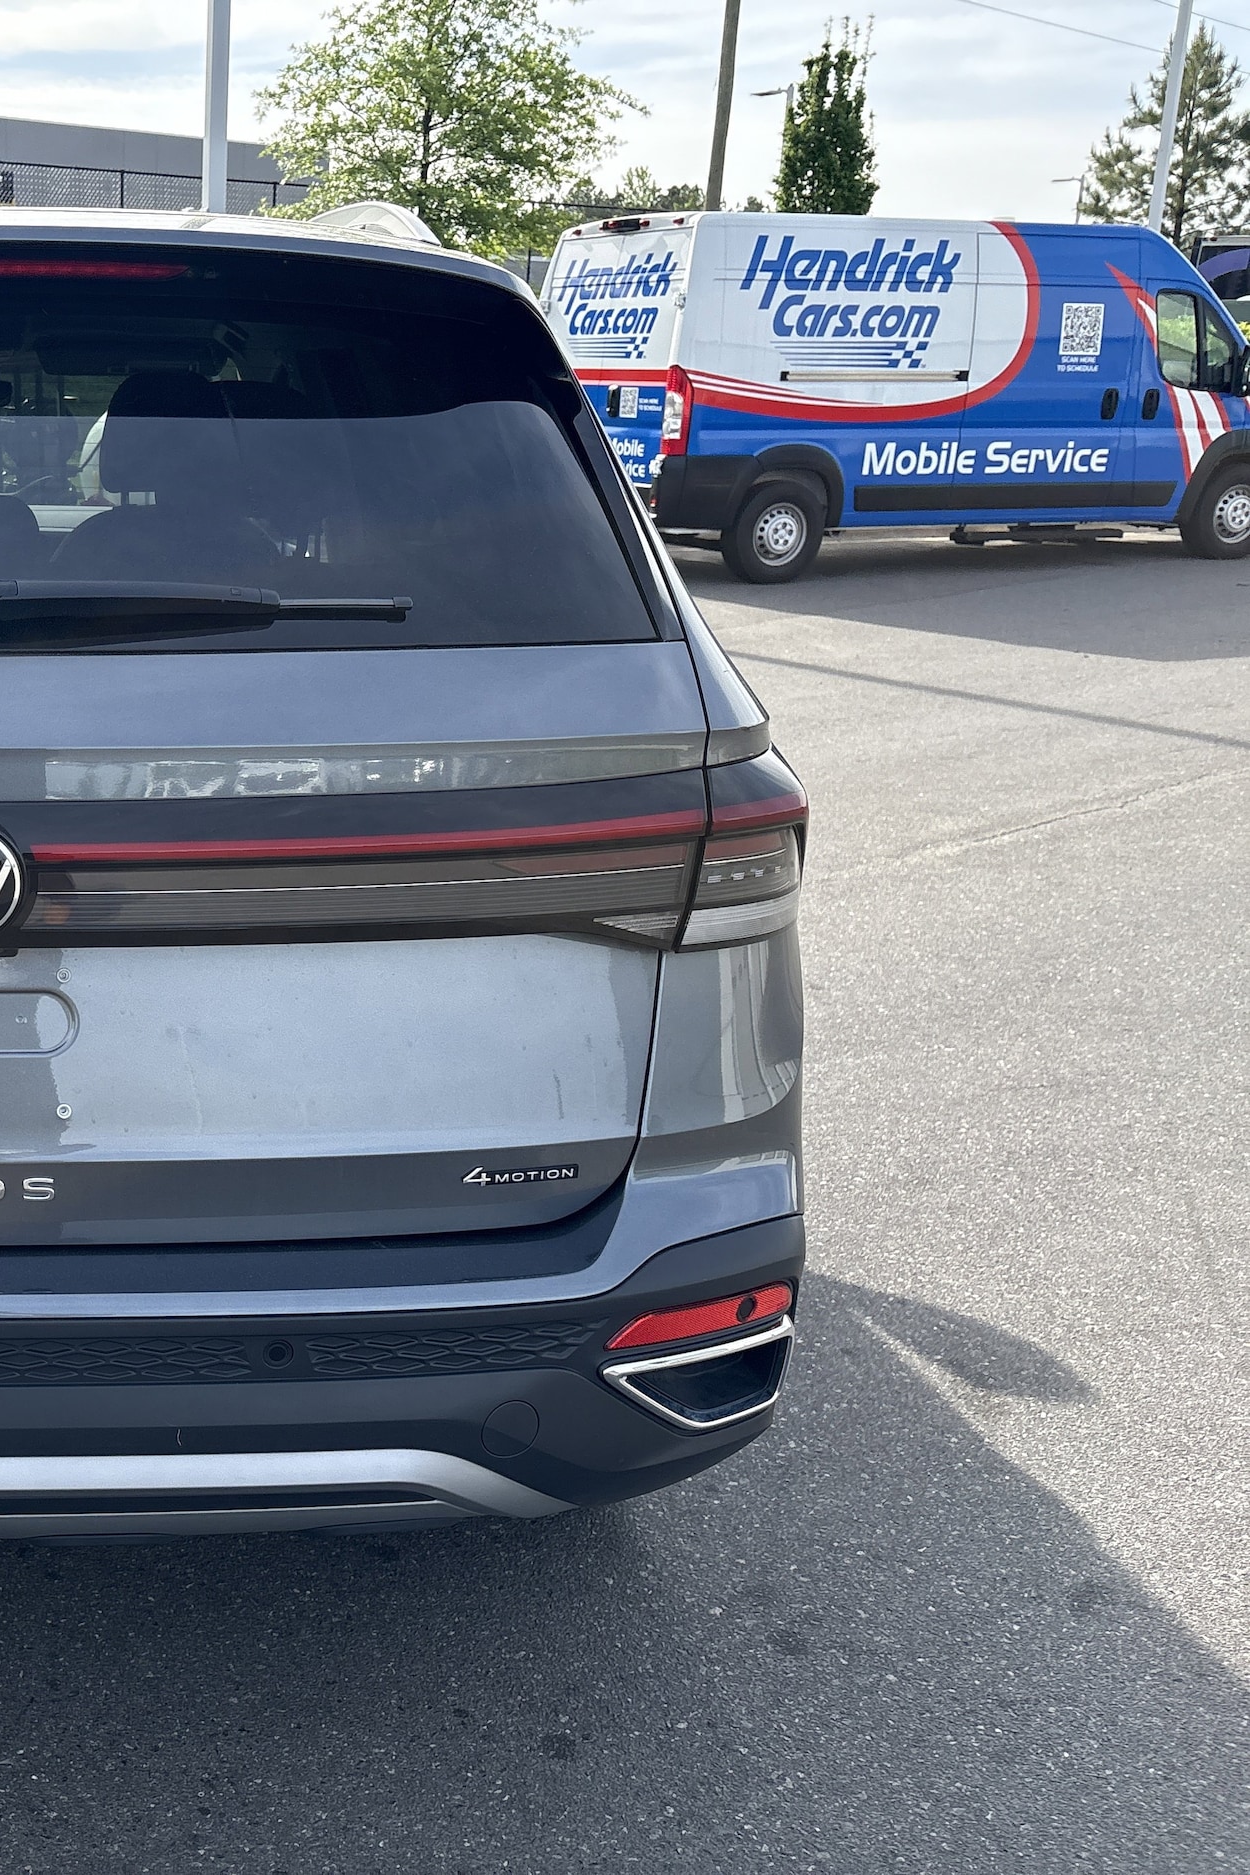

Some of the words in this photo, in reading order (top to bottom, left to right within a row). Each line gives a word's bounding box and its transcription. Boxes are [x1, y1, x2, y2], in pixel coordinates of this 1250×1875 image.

[557, 251, 679, 315] Hendrick
[740, 234, 961, 310] Hendrick
[569, 303, 659, 335] Cars.com
[772, 294, 940, 338] Cars.com
[623, 459, 646, 478] vice
[861, 441, 977, 476] Mobile
[984, 440, 1110, 475] Service
